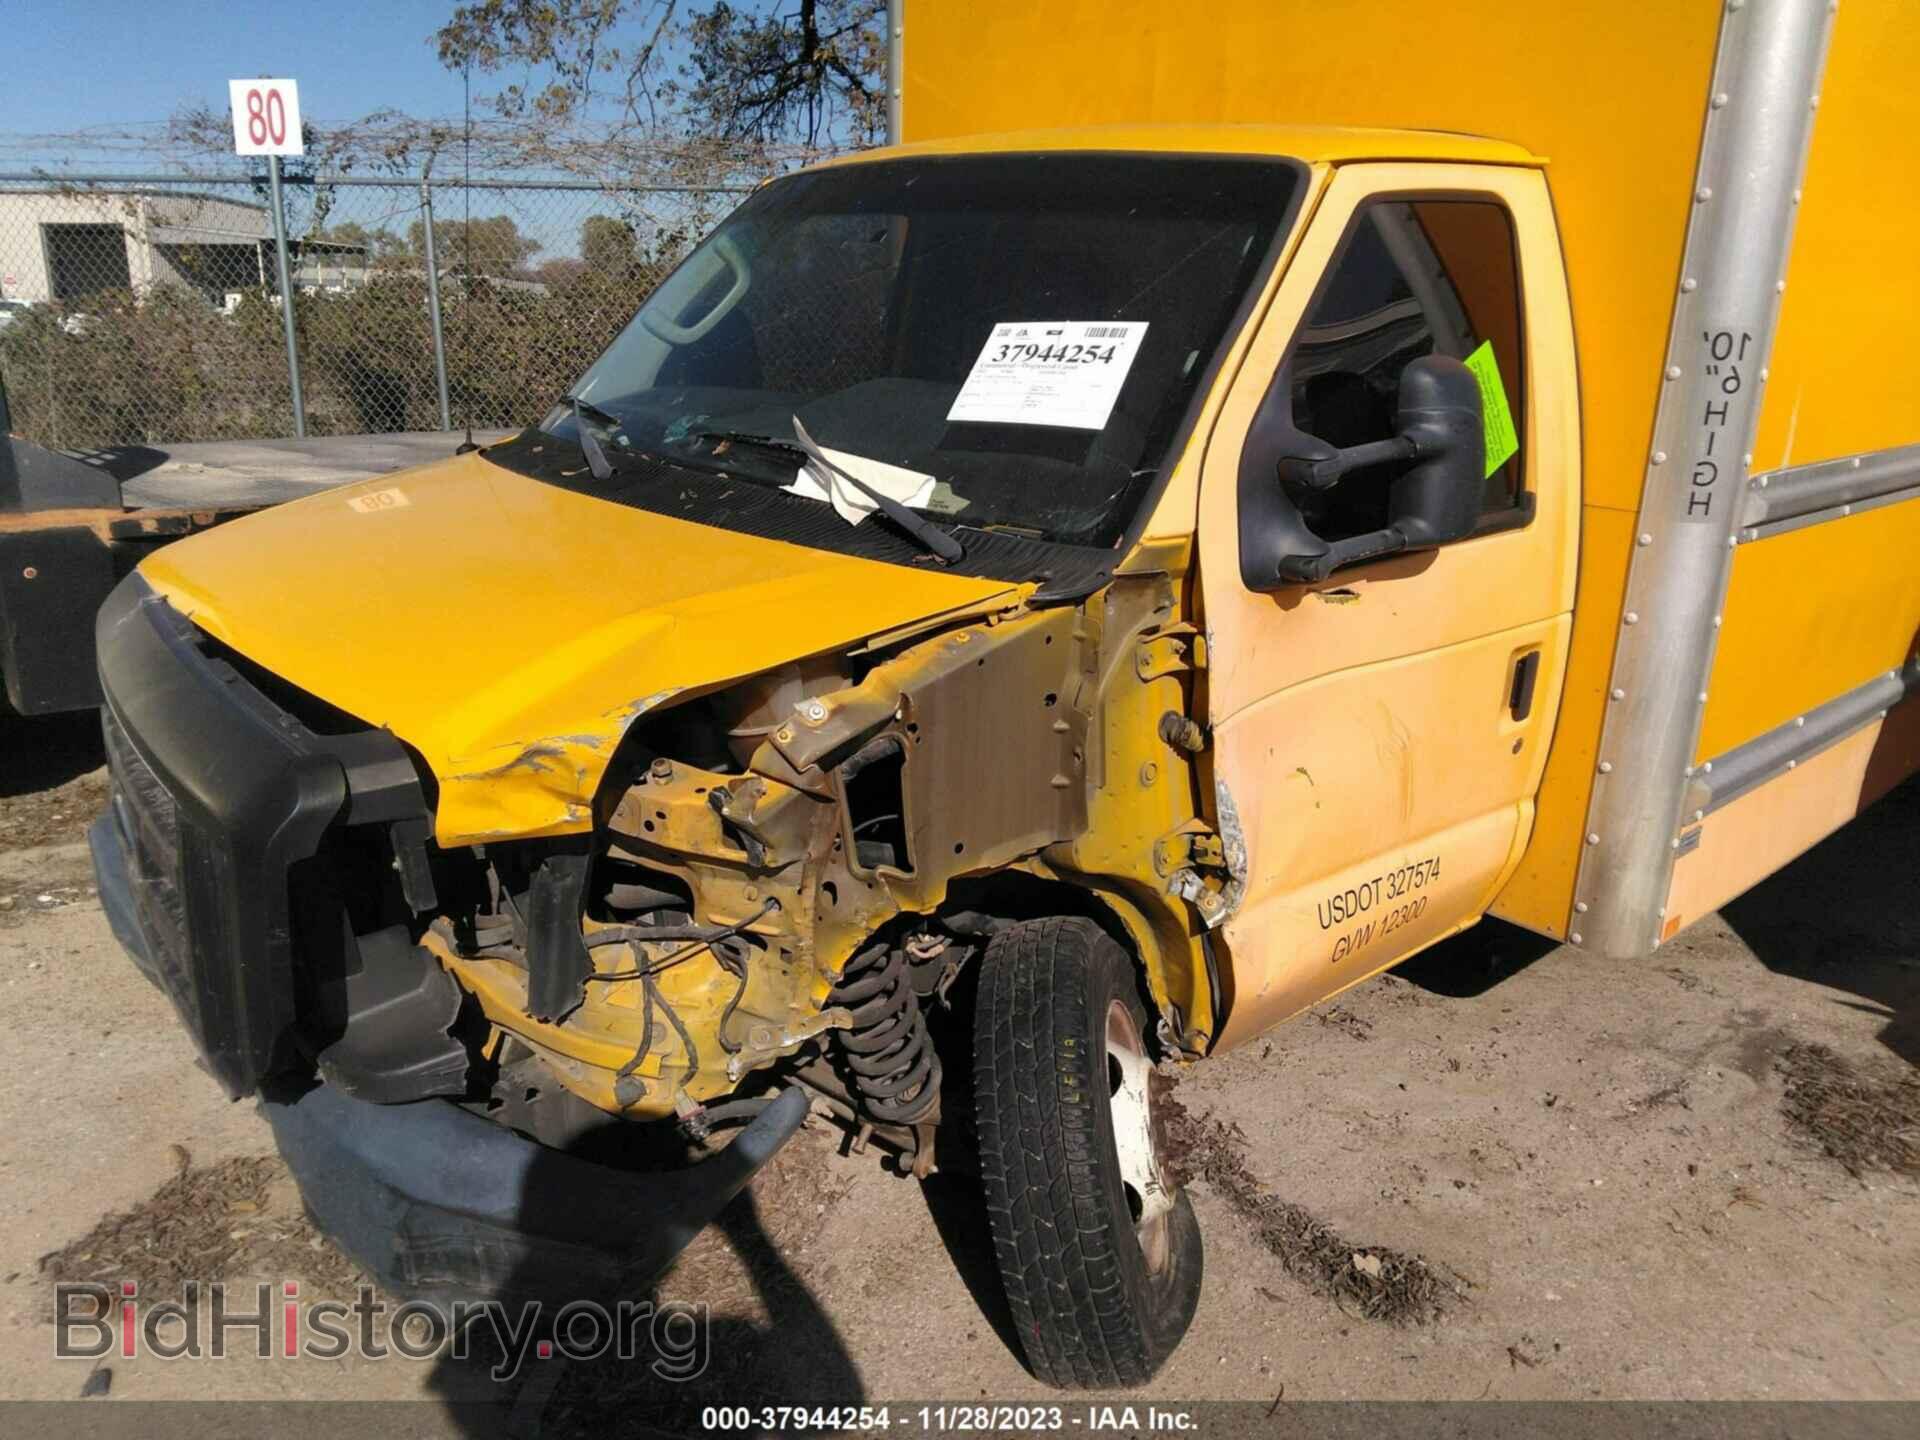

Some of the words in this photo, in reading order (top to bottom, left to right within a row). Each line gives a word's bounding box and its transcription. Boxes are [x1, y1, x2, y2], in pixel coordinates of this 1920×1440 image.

[247, 88, 286, 146] 80
[992, 343, 1117, 364] 37944254
[1318, 876, 1383, 930] USDOT
[1386, 856, 1441, 900] 327574
[1331, 920, 1377, 963] GVW
[1379, 895, 1428, 938] 12300
